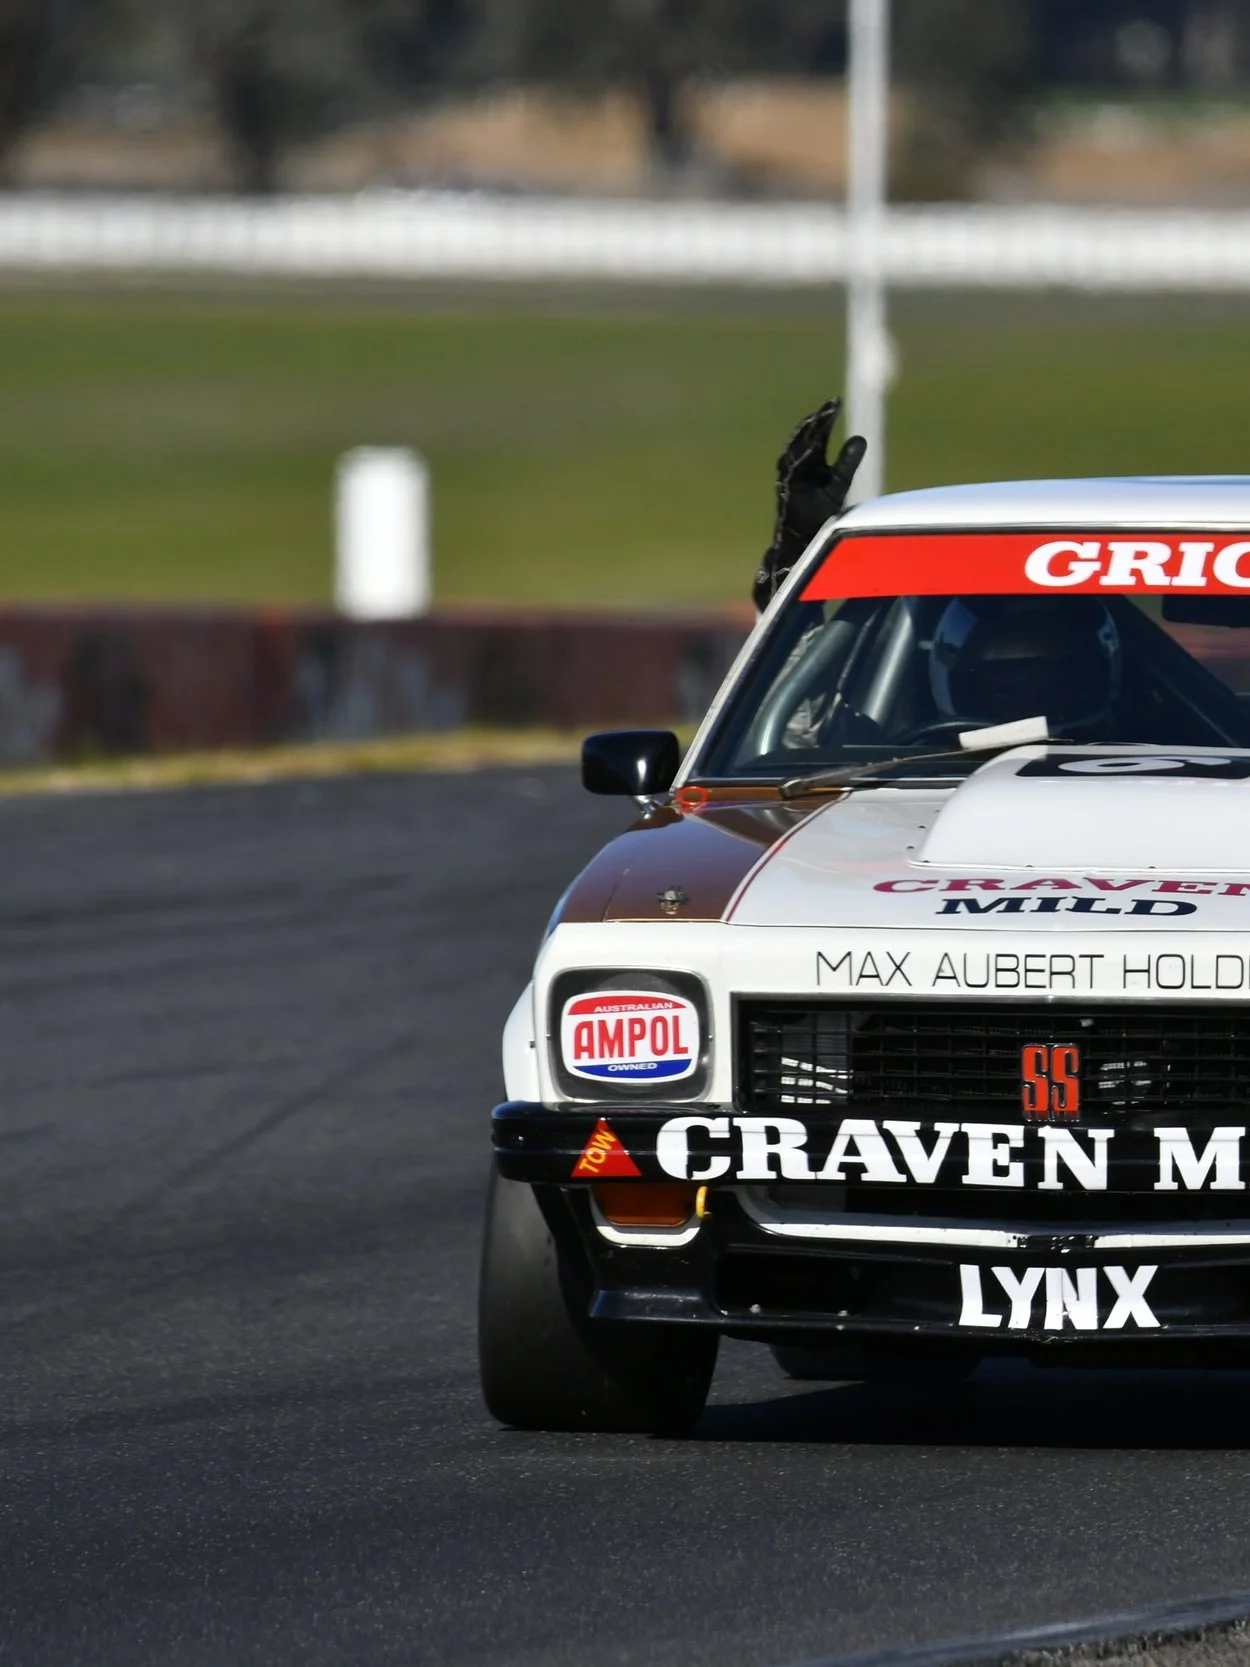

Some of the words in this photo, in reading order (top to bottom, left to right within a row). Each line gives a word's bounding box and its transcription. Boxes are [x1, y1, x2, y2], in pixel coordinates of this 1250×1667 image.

[934, 895, 1199, 917] MILD
[815, 950, 912, 987] MAX
[931, 951, 1105, 989] AUBERT
[593, 1001, 673, 1013] AUSTRALIAN
[573, 1015, 689, 1061] AMPOL
[607, 1062, 658, 1072] OWNED
[1022, 1044, 1080, 1113] SS
[579, 1128, 617, 1174] TOW
[656, 1116, 1116, 1191] CRAVEN
[958, 1263, 1162, 1331] LYNX
